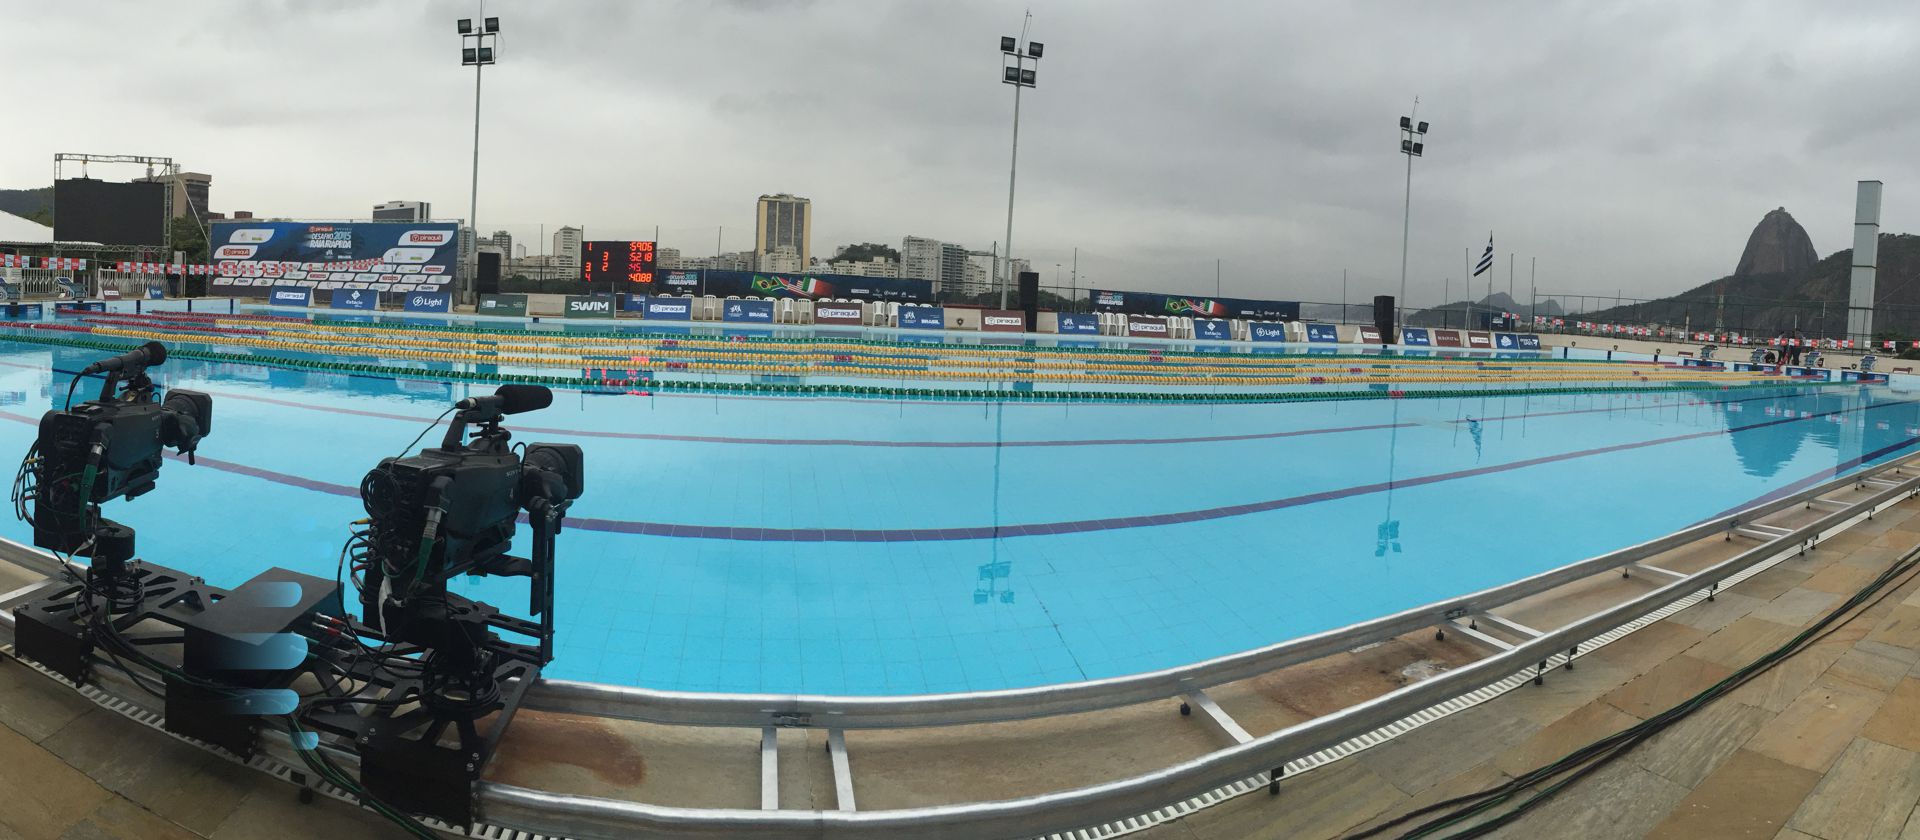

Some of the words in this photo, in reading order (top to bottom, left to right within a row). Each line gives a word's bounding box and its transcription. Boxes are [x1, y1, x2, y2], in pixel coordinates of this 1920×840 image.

[333, 231, 351, 240] 2015
[603, 251, 609, 261] 3
[585, 262, 592, 272] 3
[602, 262, 609, 272] 2
[585, 273, 591, 282] 4
[424, 298, 442, 307] Light
[570, 301, 609, 311] SWIM
[1265, 329, 1280, 337] Light
